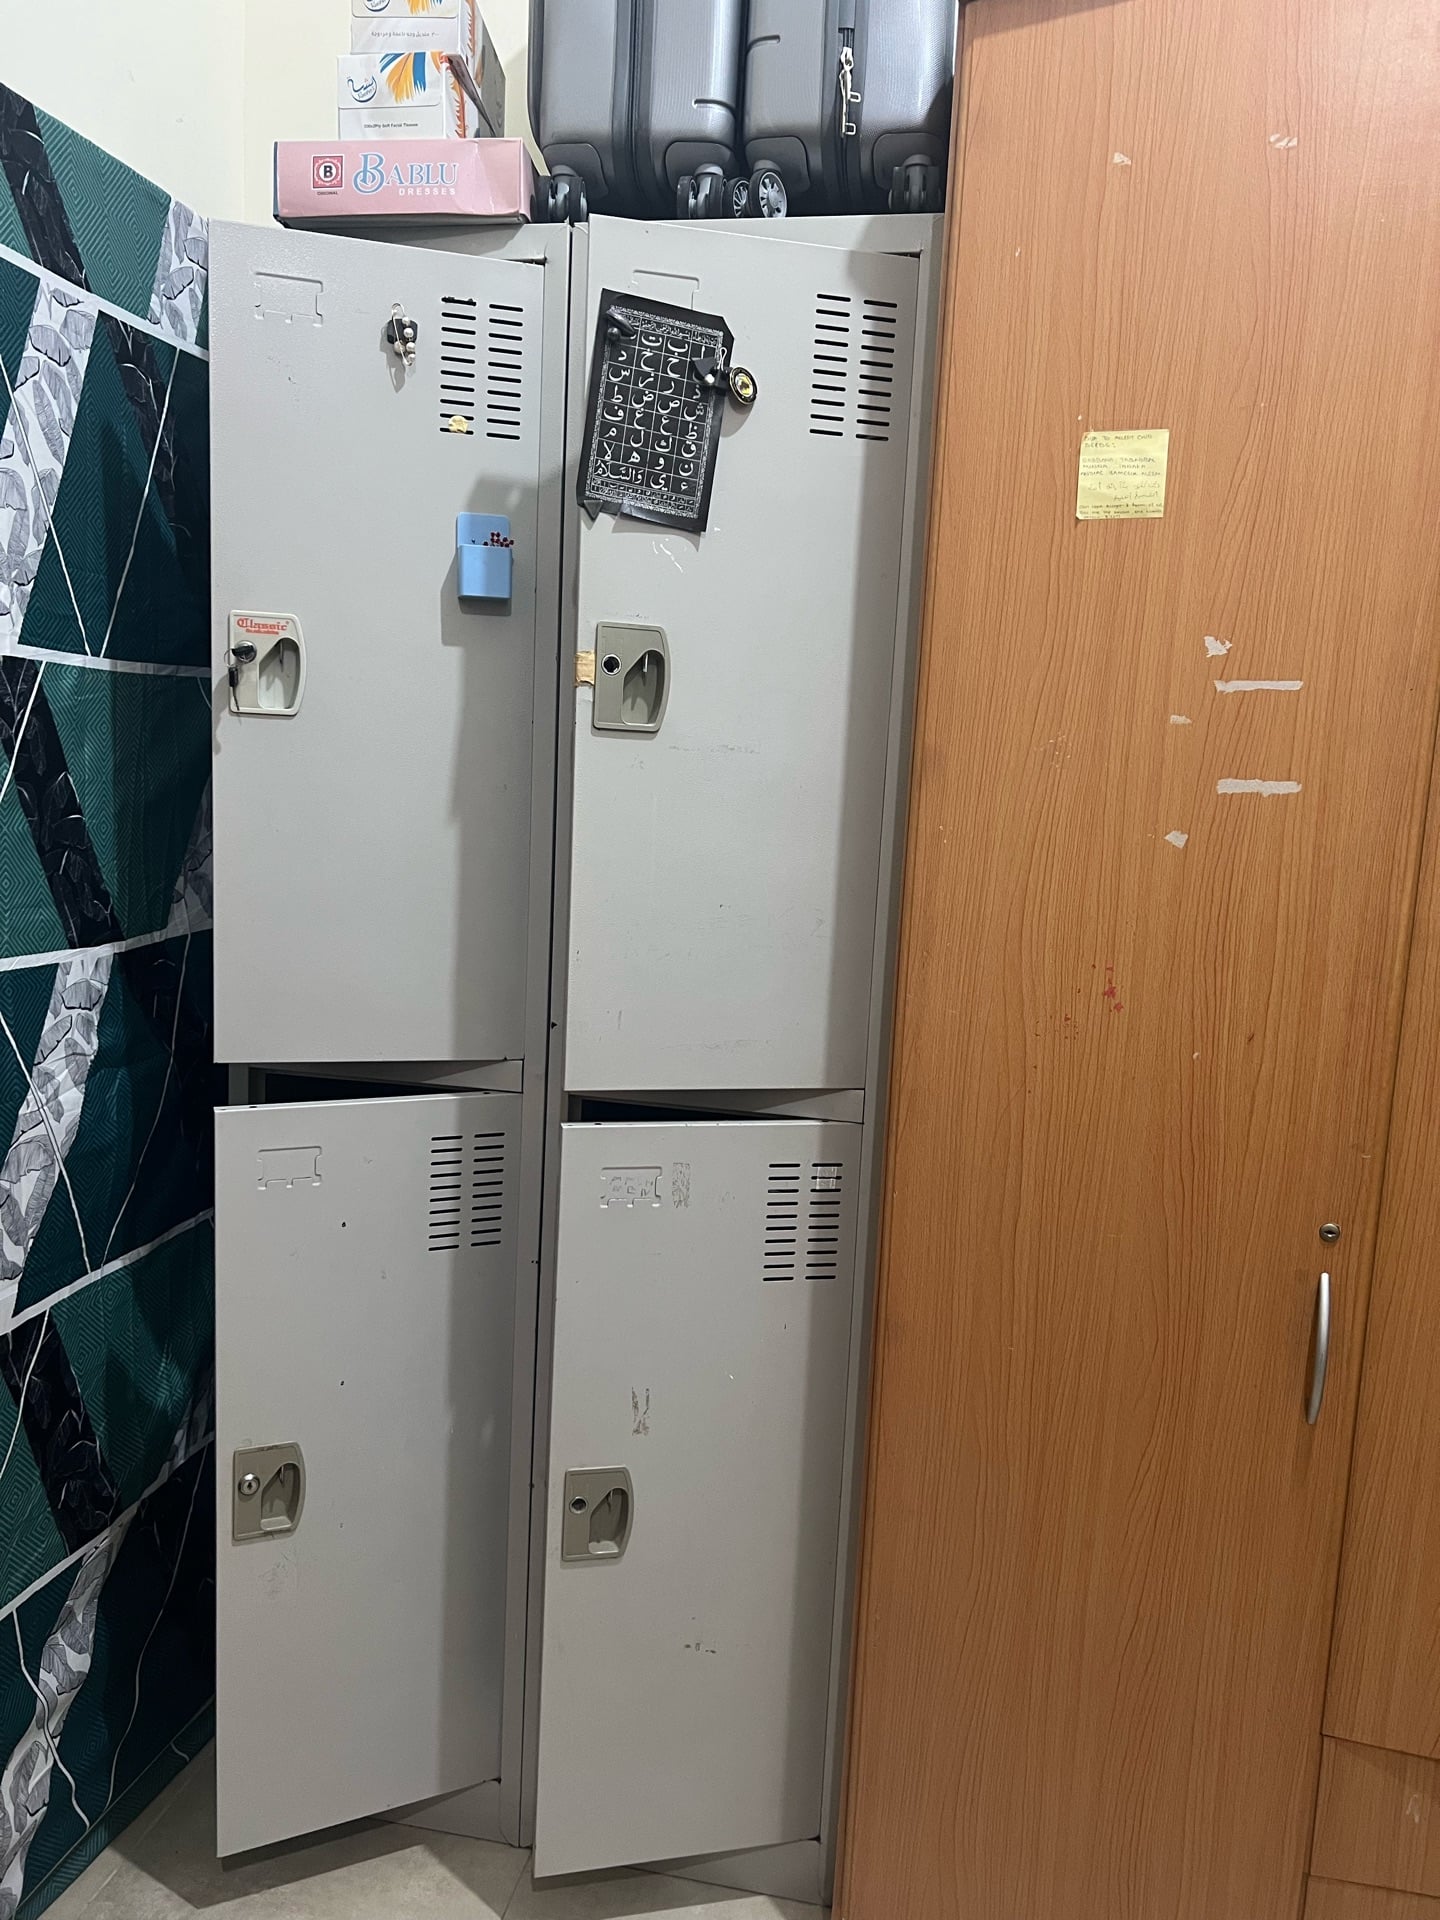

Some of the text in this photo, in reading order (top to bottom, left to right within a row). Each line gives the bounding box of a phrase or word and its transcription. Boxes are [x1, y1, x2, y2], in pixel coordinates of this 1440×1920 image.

[323, 165, 333, 178] B
[353, 152, 459, 194] BABLU
[398, 187, 457, 196] DRESSES
